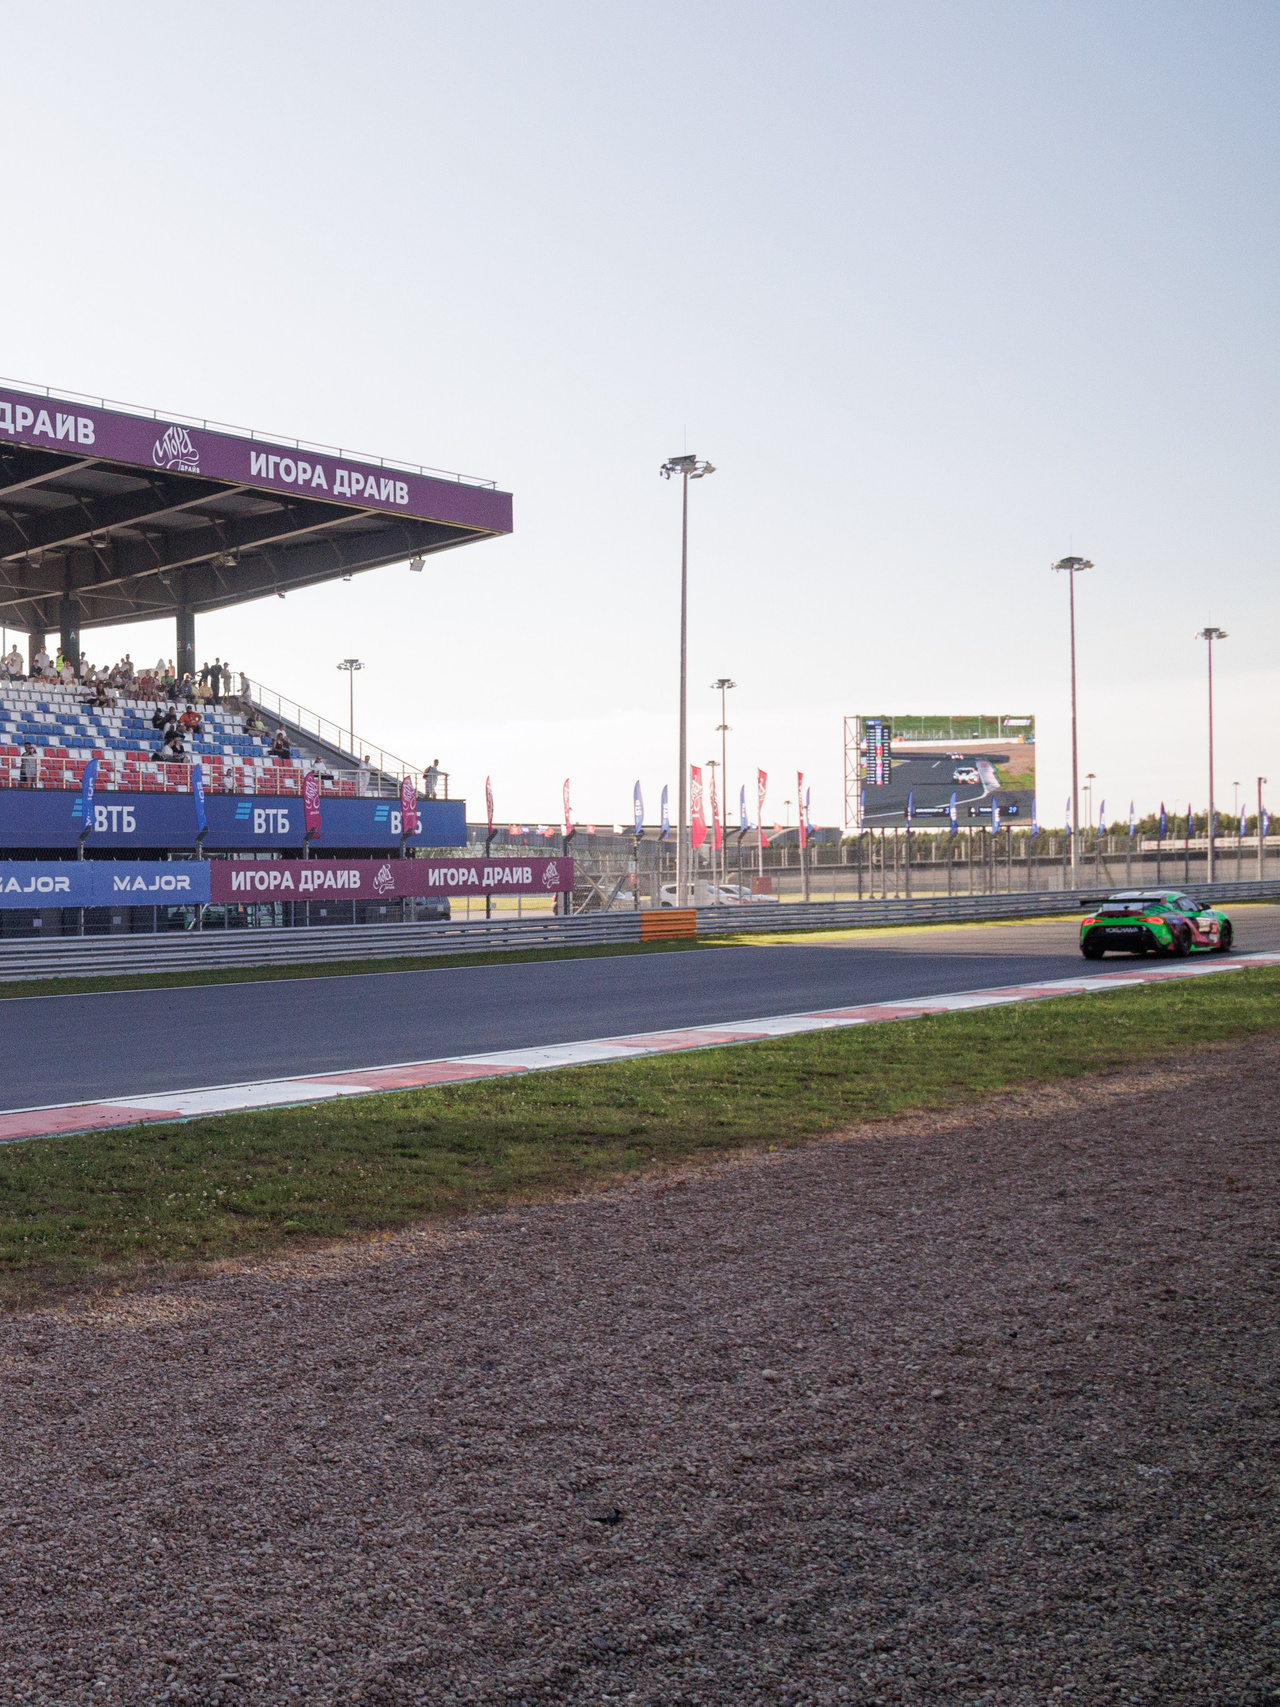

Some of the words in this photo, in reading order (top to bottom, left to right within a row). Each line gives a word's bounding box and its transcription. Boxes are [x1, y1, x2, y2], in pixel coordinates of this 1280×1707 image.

[250, 451, 329, 490] ИГОРА
[333, 469, 409, 505] ДРАЙВ
[94, 805, 137, 833] ВТБ
[253, 808, 290, 834] ВТБ
[113, 875, 191, 891] MAJOR
[231, 871, 295, 891] ИГОРА
[299, 869, 361, 892] ДРАЙВ
[428, 868, 479, 886] ИГОРА
[482, 866, 533, 887] ДРАЙВ
